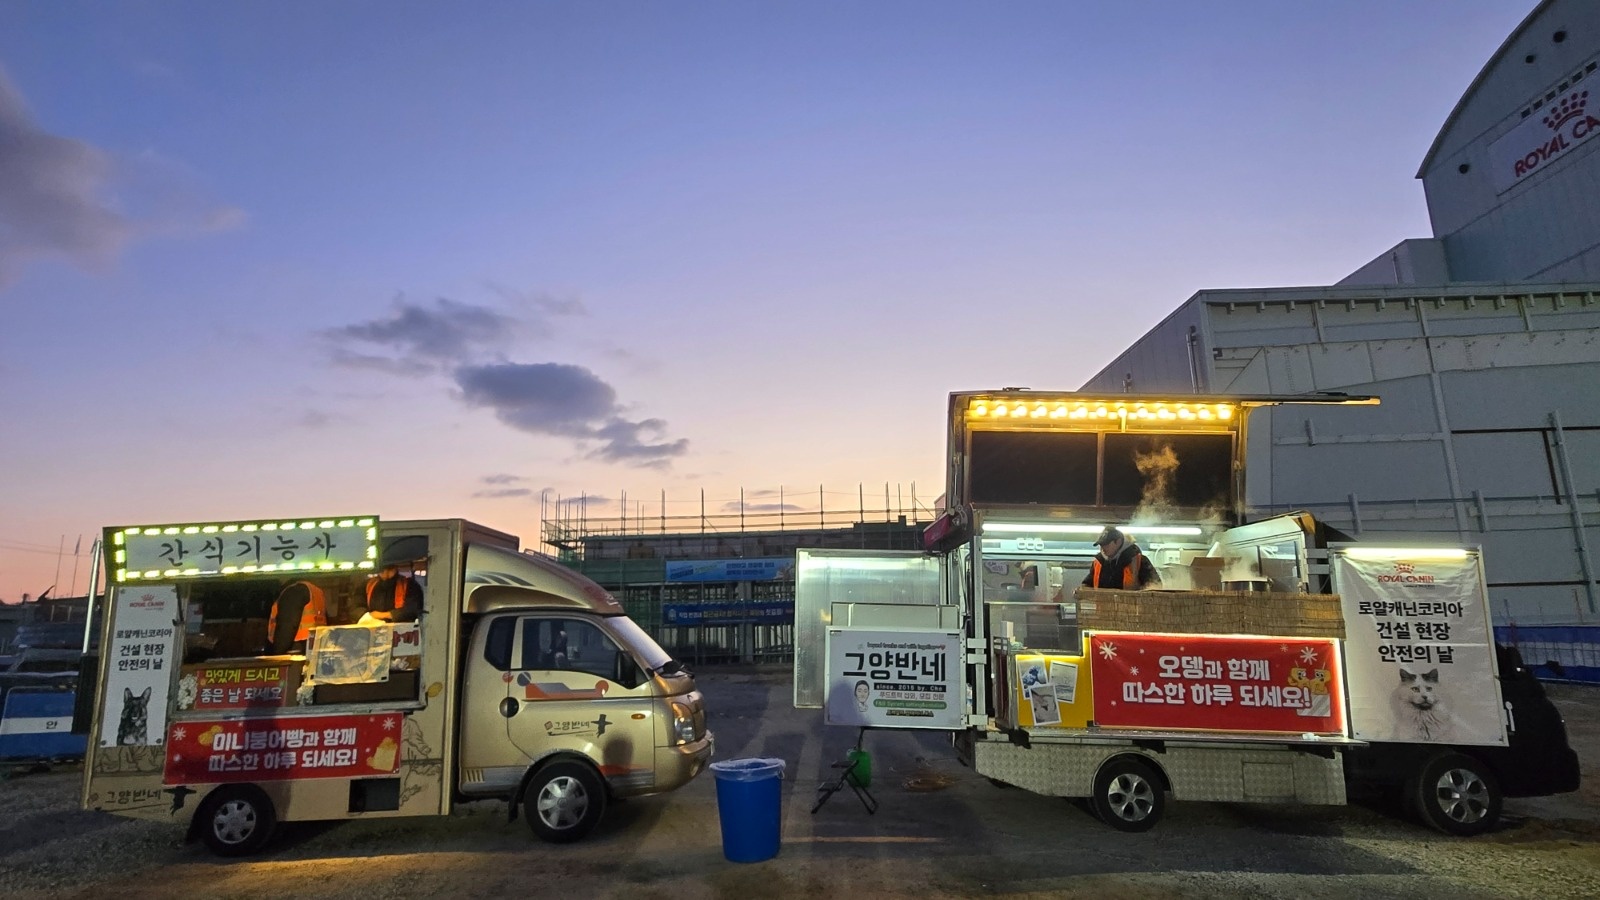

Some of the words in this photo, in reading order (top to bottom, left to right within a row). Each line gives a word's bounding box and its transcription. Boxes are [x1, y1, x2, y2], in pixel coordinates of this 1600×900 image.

[1514, 133, 1570, 177] ROYAL
[1377, 575, 1404, 584] ROYAL
[1405, 575, 1434, 584] CANIN
[1358, 601, 1463, 618] 로얄캐닌코리아
[116, 628, 172, 639] 로얄캐닌코리아
[1376, 621, 1411, 640] 건설
[1415, 621, 1451, 641] 현장
[120, 644, 141, 657] 건설
[144, 643, 165, 656] 현장
[1378, 645, 1431, 663] 안전의
[1436, 645, 1454, 664] 날
[118, 659, 150, 671] 안전의
[152, 658, 163, 670] 날
[843, 650, 946, 682] 그양반네
[1158, 655, 1223, 680] 오뎅과
[1227, 656, 1271, 681] 함께
[205, 668, 241, 684] 맛있게
[244, 667, 280, 682] 드시고
[201, 687, 224, 704] 좋은
[228, 687, 241, 703] 날
[1122, 681, 1185, 705] 따스한
[1191, 684, 1234, 706] 하루
[1239, 685, 1313, 708] 되세요!
[212, 729, 319, 751] 미니붕어빵과
[323, 728, 357, 746] 함께
[208, 752, 259, 771] 따스한
[264, 751, 297, 769] 하루
[301, 749, 357, 768] 되세요!
